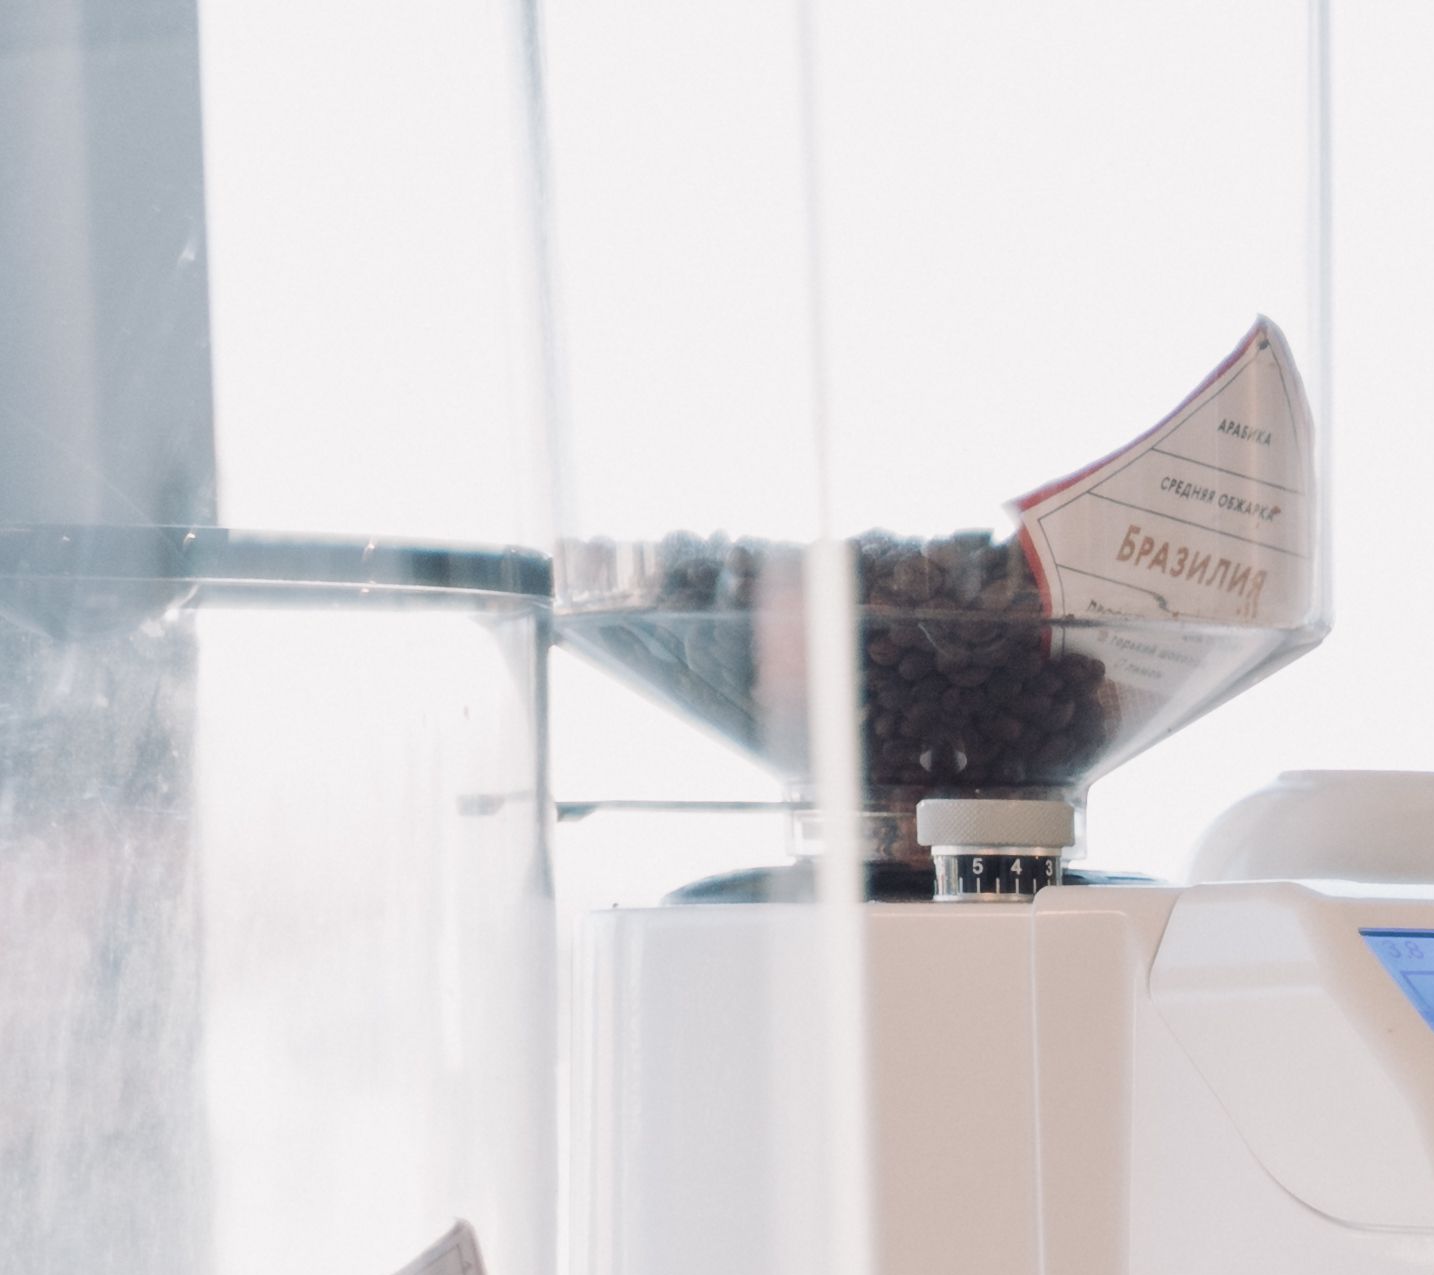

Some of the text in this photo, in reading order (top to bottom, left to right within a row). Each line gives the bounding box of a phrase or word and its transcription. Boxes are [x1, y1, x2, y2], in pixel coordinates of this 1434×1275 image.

[1217, 418, 1272, 447] АРАБИКА
[1160, 476, 1275, 522] СРЕДНЯЯ ОБЖАРКА
[1116, 524, 1267, 606] БРАЗИЛИЯ
[972, 857, 1053, 877] 5 4 3
[1382, 940, 1425, 959] 3.8
